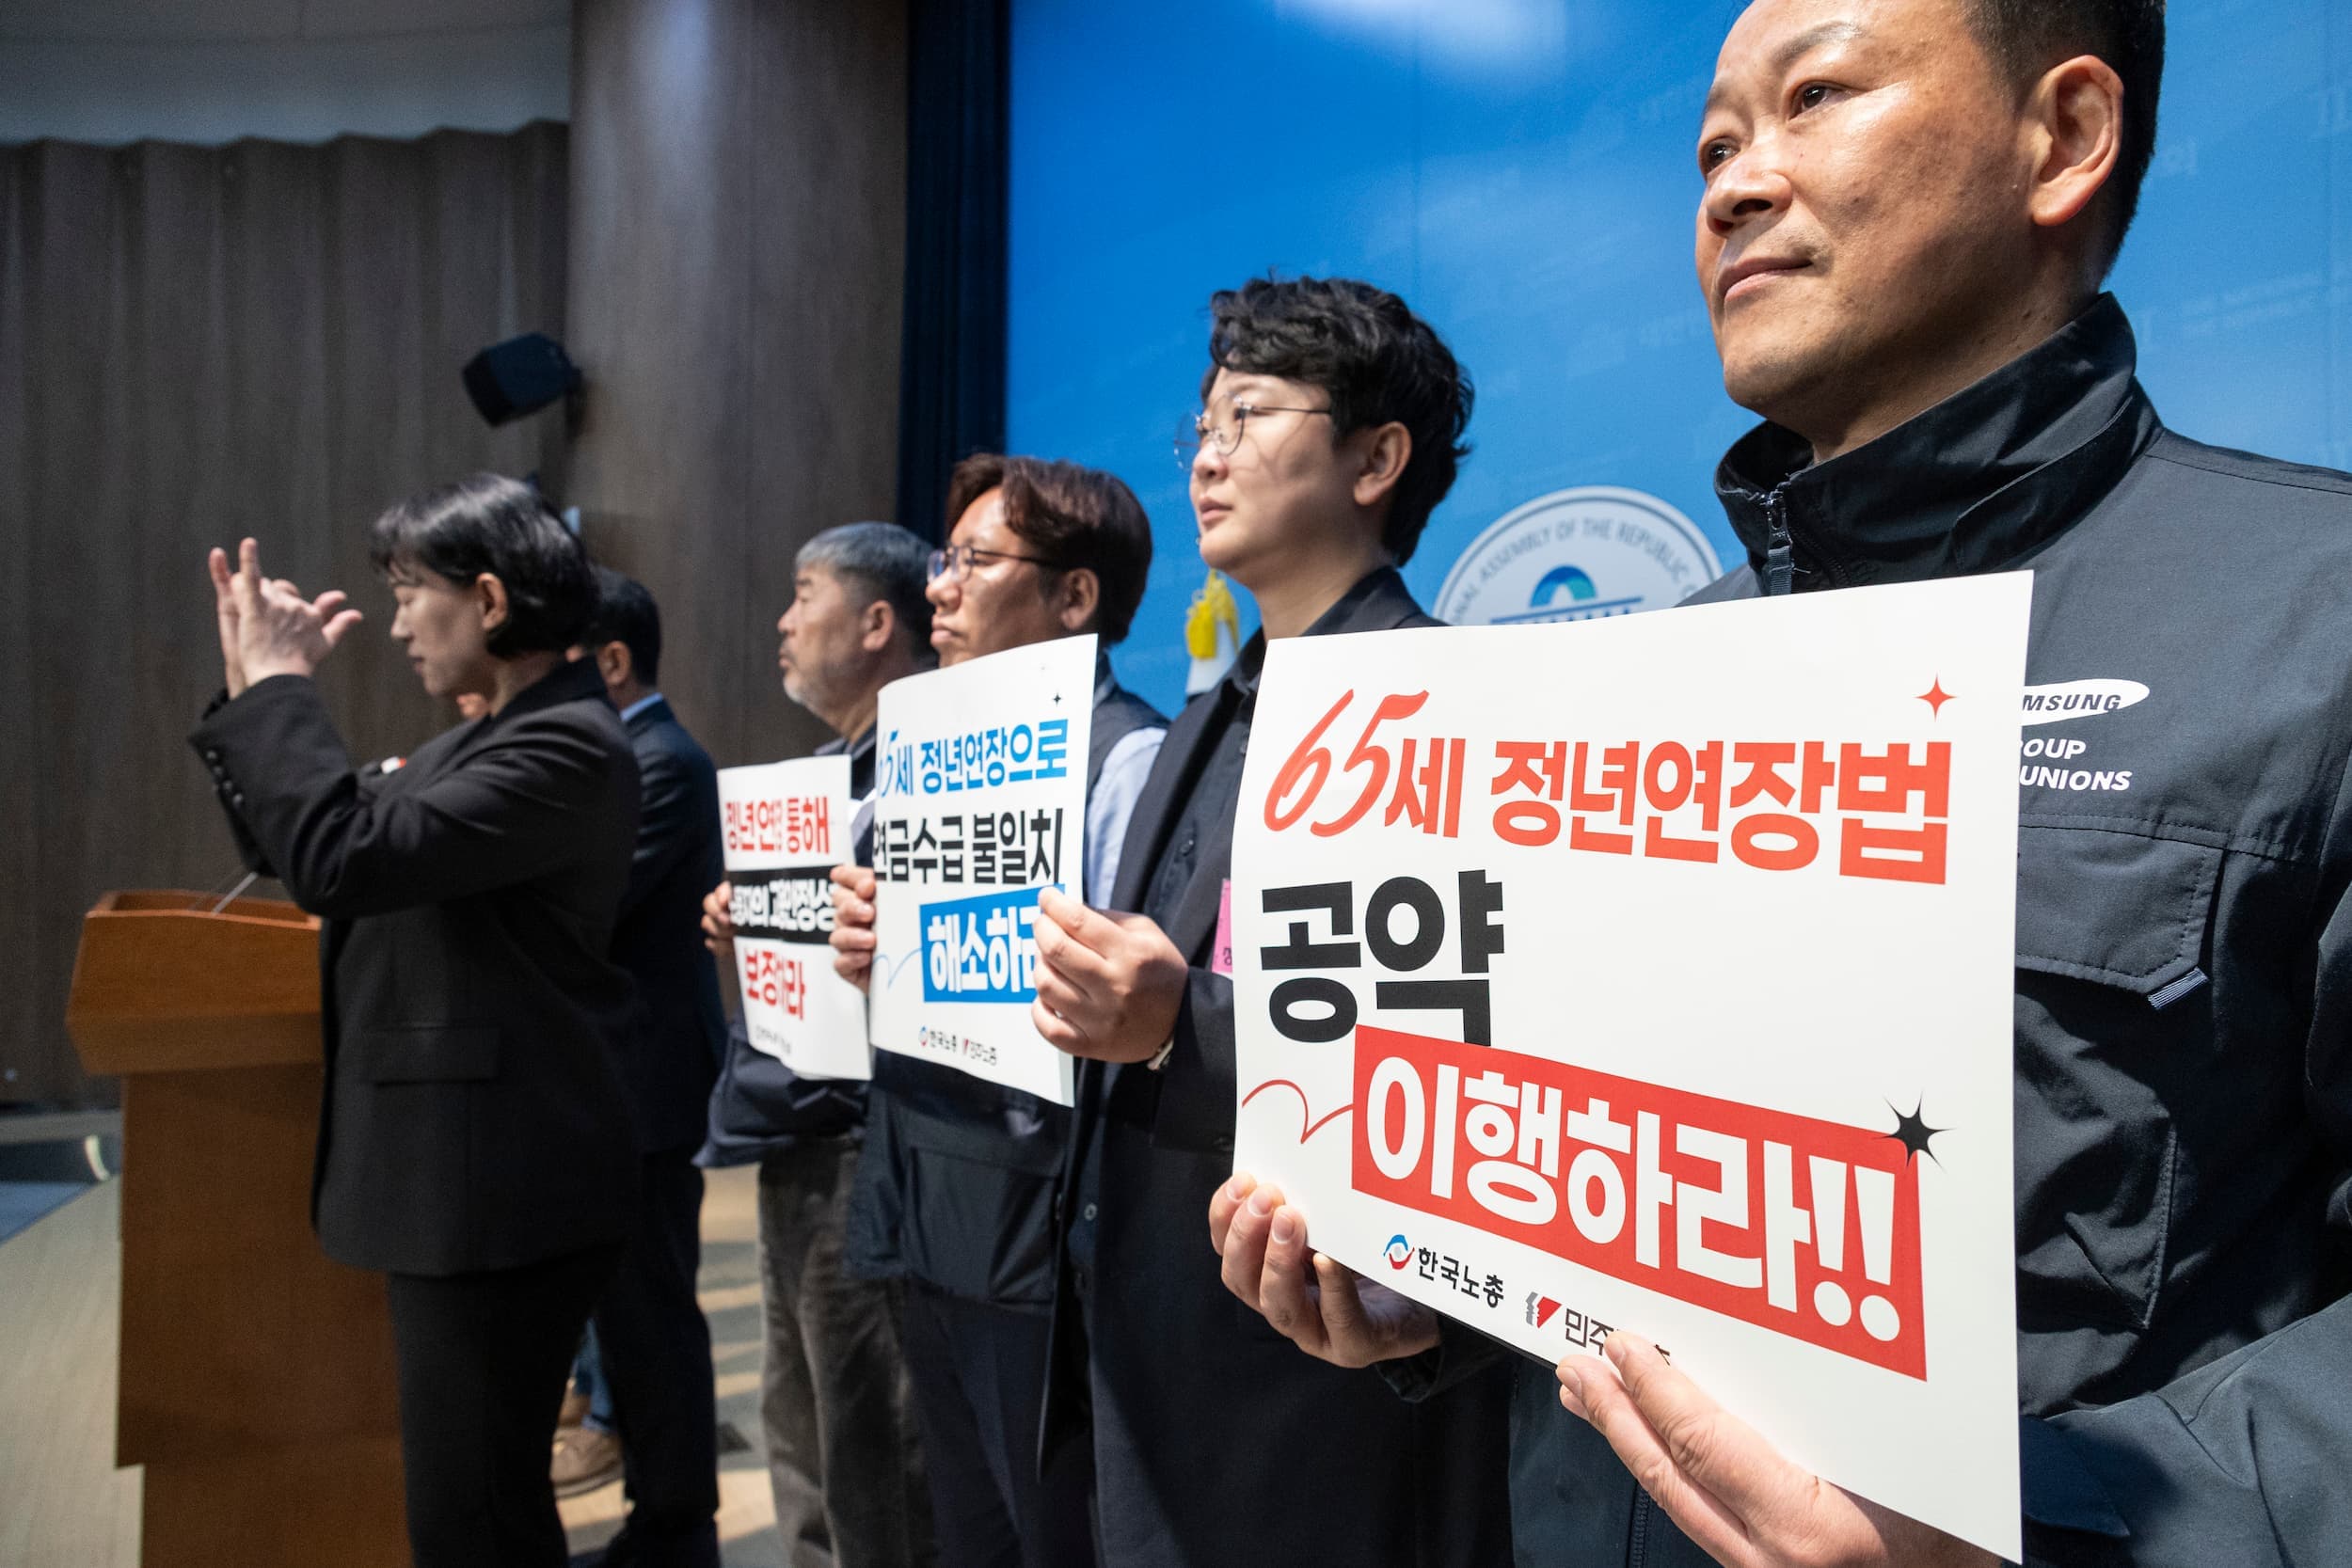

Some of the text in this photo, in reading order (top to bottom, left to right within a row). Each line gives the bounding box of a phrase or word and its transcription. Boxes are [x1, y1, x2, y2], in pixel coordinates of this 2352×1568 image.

[2023, 693, 2122, 711] MSUNG
[920, 718, 1069, 795] 정년연장으로
[2019, 765, 2133, 791] UNIONS
[2021, 738, 2087, 759] OUP
[1263, 689, 1952, 886] 65세 정년연장법
[787, 796, 829, 854] 통해
[973, 807, 1064, 884] 불일치
[1260, 868, 1505, 1047] 공약
[1366, 1056, 1900, 1342] 이행하라!!
[1418, 1246, 1504, 1308] 한국노총
